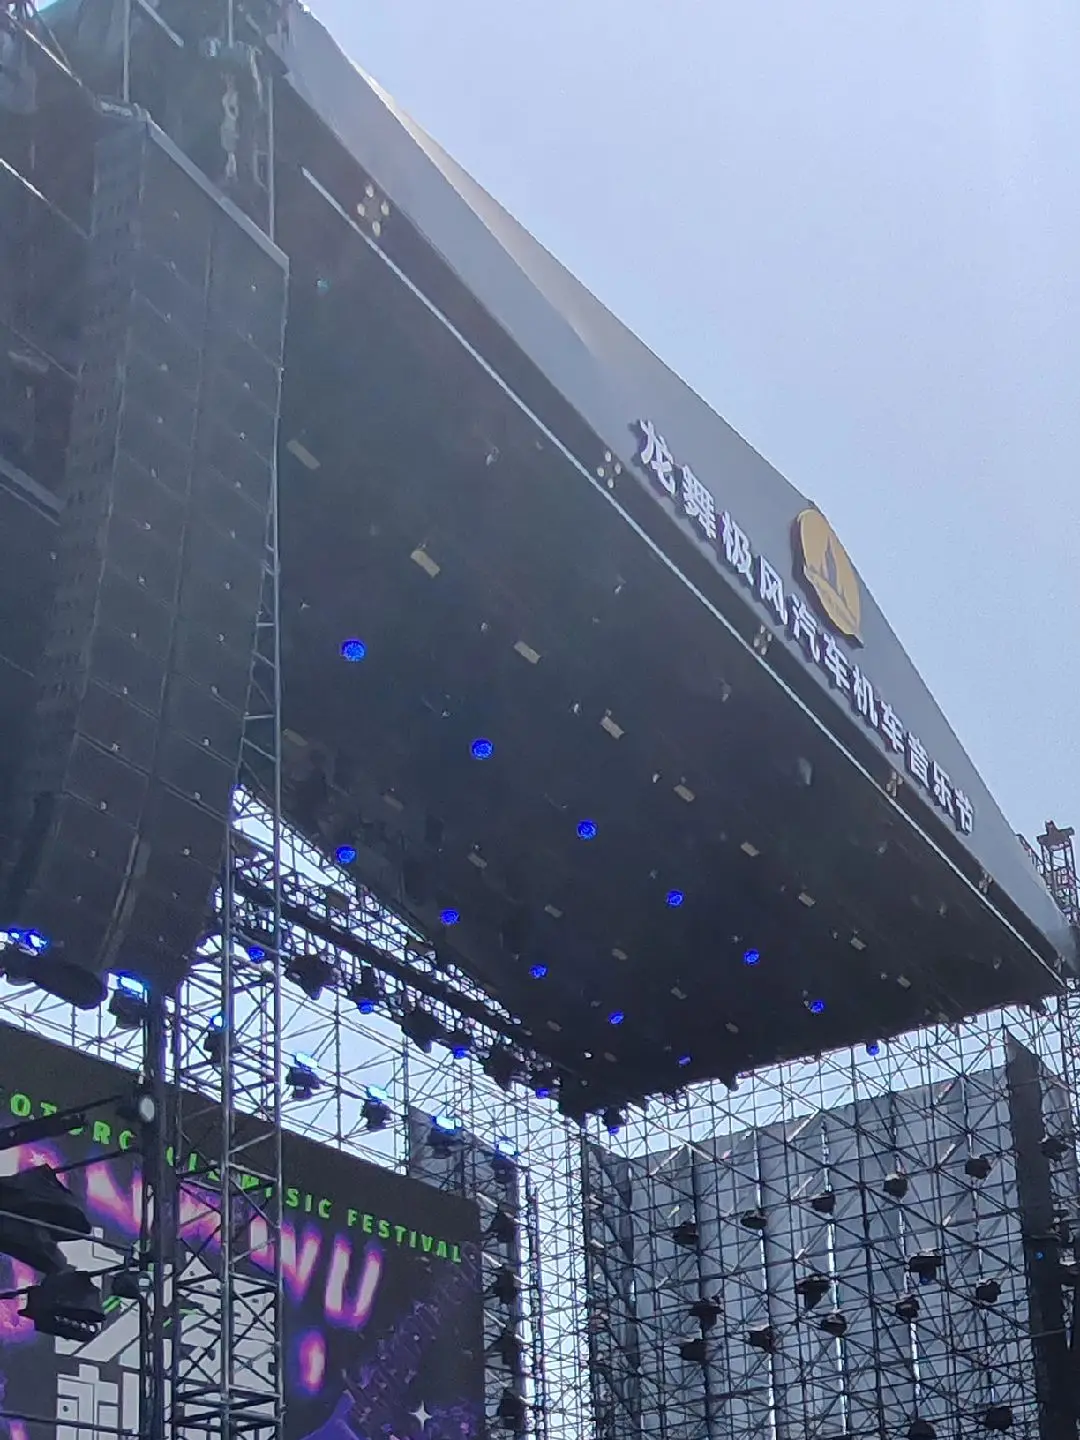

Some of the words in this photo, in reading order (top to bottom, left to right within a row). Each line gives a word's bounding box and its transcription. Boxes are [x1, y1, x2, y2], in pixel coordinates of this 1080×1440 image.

[639, 418, 975, 834] 龙舞极风汽车机车音乐节
[239, 1175, 332, 1220] MSIC
[346, 1208, 462, 1264] FESTIVAL
